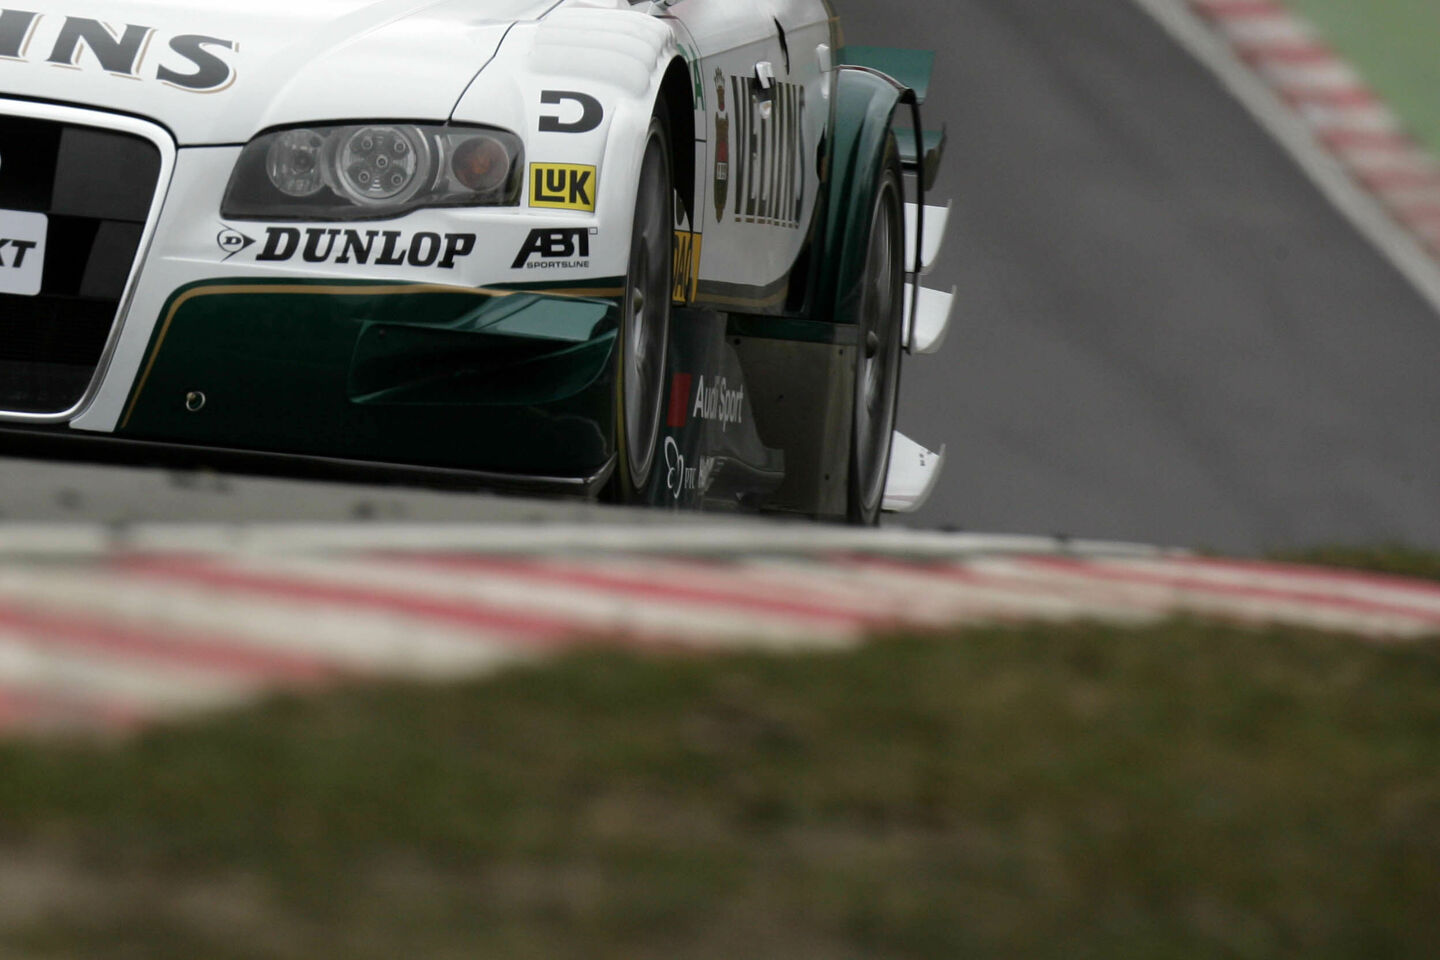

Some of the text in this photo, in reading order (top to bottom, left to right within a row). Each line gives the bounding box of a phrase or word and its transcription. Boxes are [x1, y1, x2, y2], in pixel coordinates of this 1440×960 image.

[730, 75, 806, 228] VELTINS
[254, 227, 477, 269] DUNLOP
[510, 227, 590, 270] ABT
[526, 261, 590, 269] SPORTSLINE
[692, 375, 744, 433] Audi Sport
